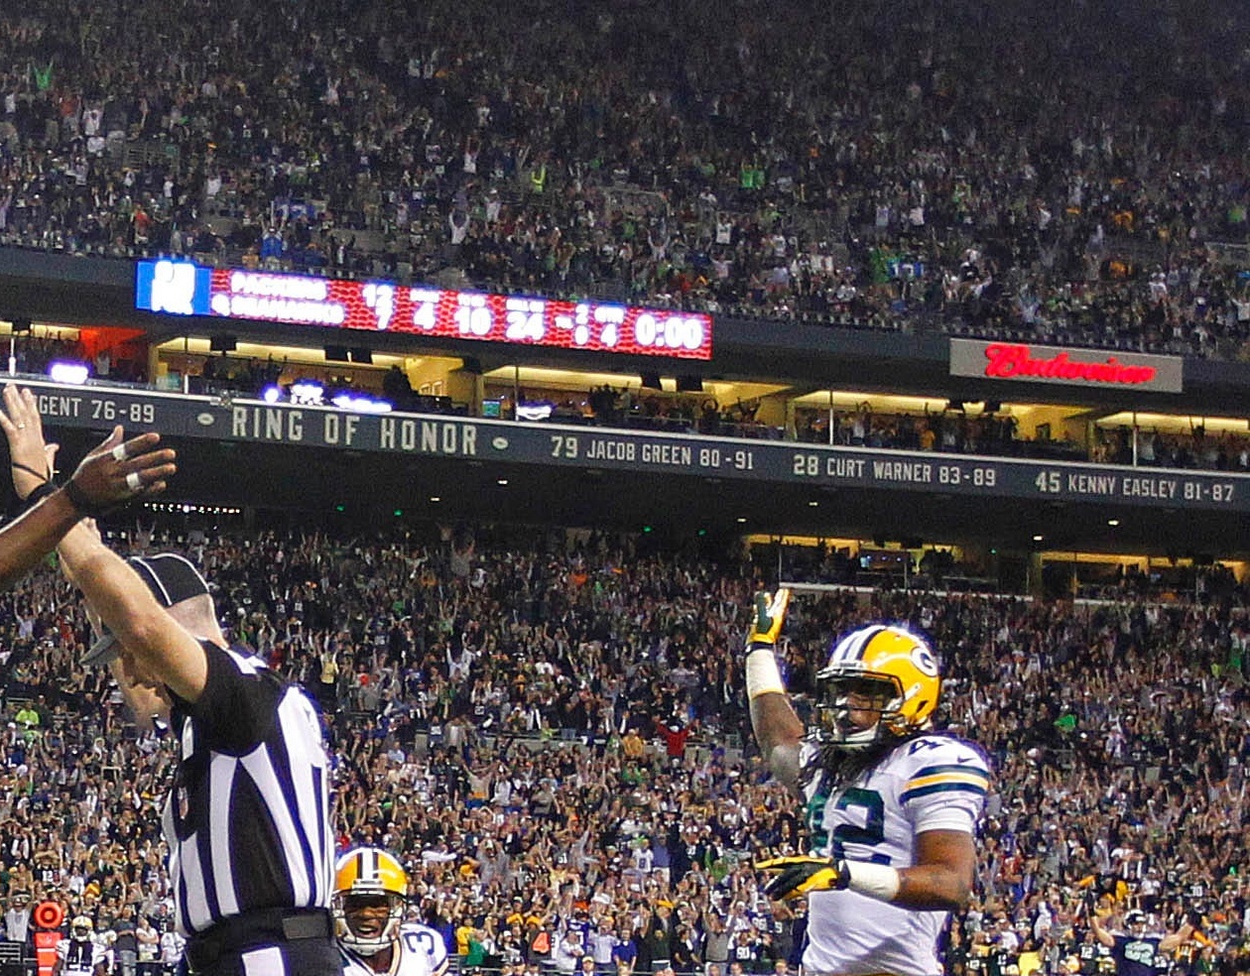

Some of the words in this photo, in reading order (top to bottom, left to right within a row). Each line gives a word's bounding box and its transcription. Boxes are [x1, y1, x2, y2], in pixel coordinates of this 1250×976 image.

[454, 306, 491, 335] 10
[506, 311, 545, 340] 24
[635, 314, 703, 349] 0:00
[34, 396, 82, 418] GENT
[91, 399, 155, 423] 76-89
[232, 406, 303, 441] RING
[324, 413, 360, 446] OF
[380, 418, 477, 456] HONOR
[551, 436, 578, 458] 79
[587, 440, 636, 461] JACOB
[642, 443, 691, 466] GREEN
[700, 449, 753, 470] 80-91
[793, 454, 819, 476] 28
[826, 457, 866, 478] CURT
[874, 460, 932, 483] WARNER
[939, 466, 997, 487] 83-89
[1035, 471, 1061, 493] 45
[1068, 474, 1116, 495] KENNY
[1123, 478, 1177, 498] EASLEY
[1184, 482, 1234, 501] 81-87
